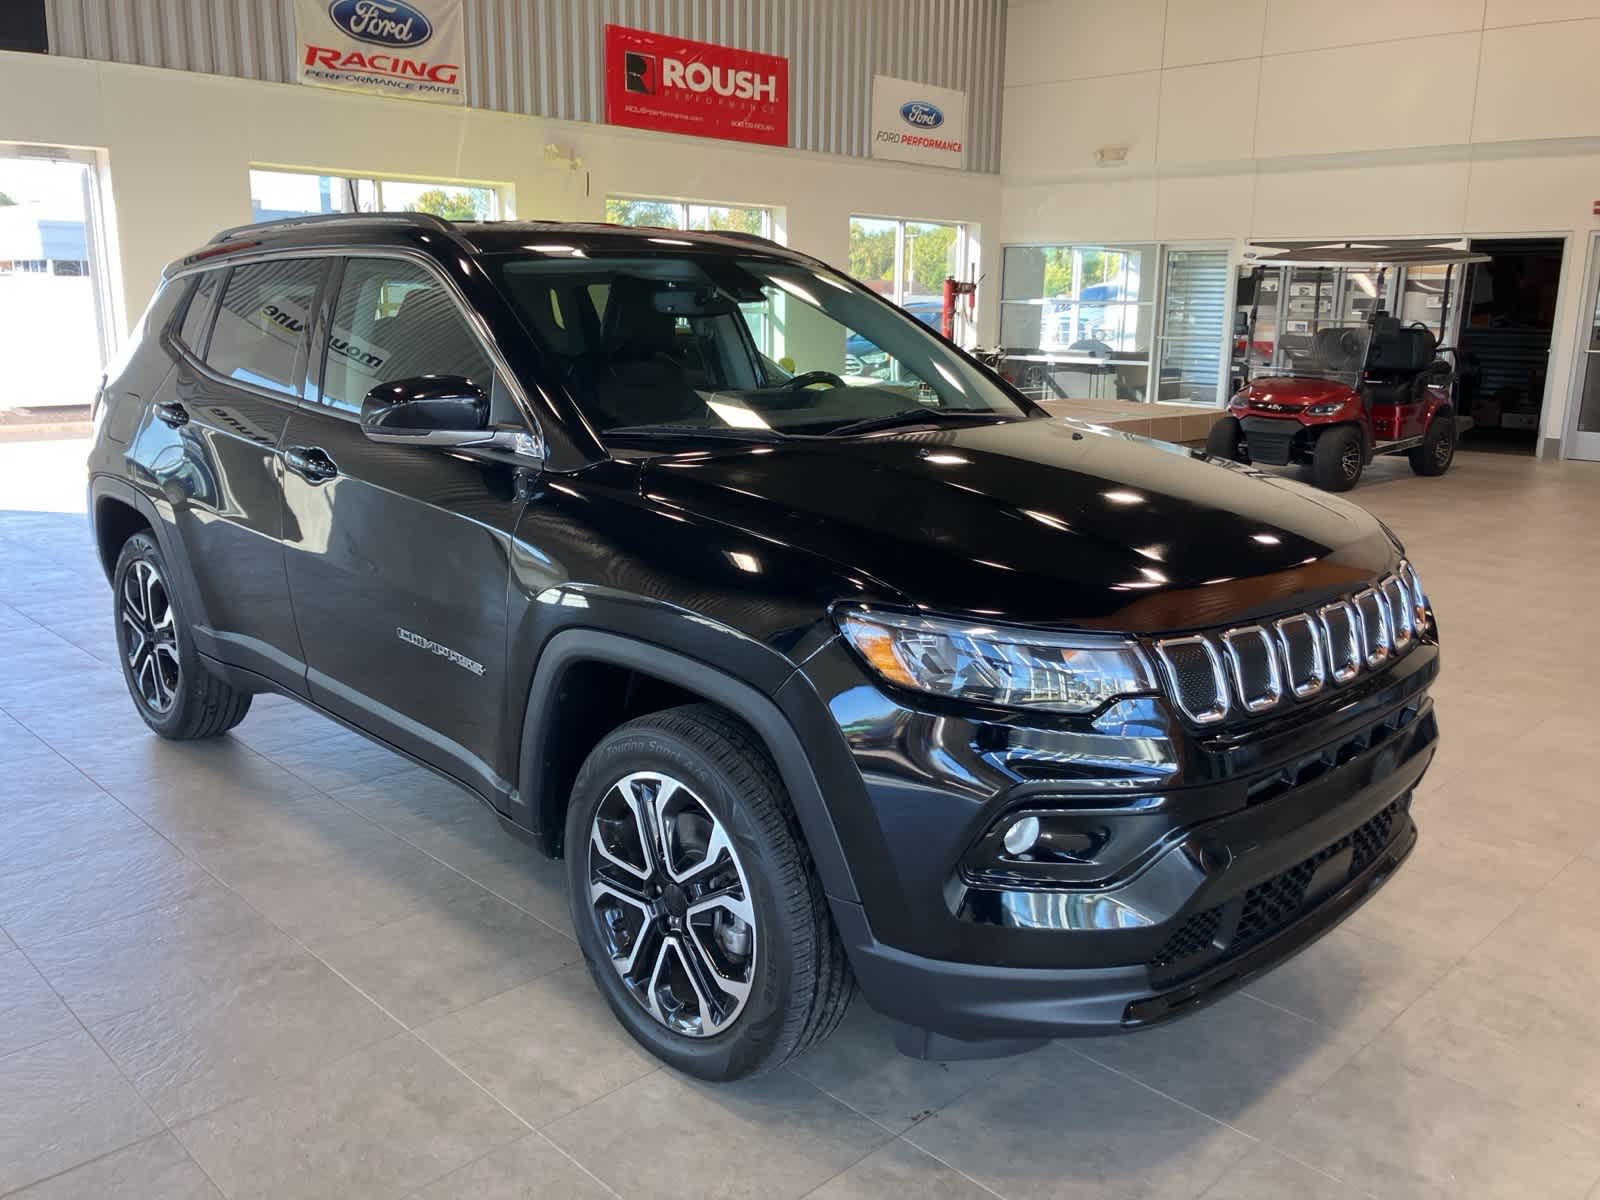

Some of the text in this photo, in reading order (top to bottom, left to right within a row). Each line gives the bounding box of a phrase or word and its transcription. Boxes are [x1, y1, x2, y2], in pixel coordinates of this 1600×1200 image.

[350, 1, 413, 41] Ford
[304, 45, 460, 85] RACING
[305, 69, 460, 96] PERFORMANCE PARTS
[662, 57, 776, 103] ROUSH
[908, 104, 936, 125] Ford
[876, 130, 962, 153] FORD PERFORMANCE
[396, 626, 484, 677] COMPASS
